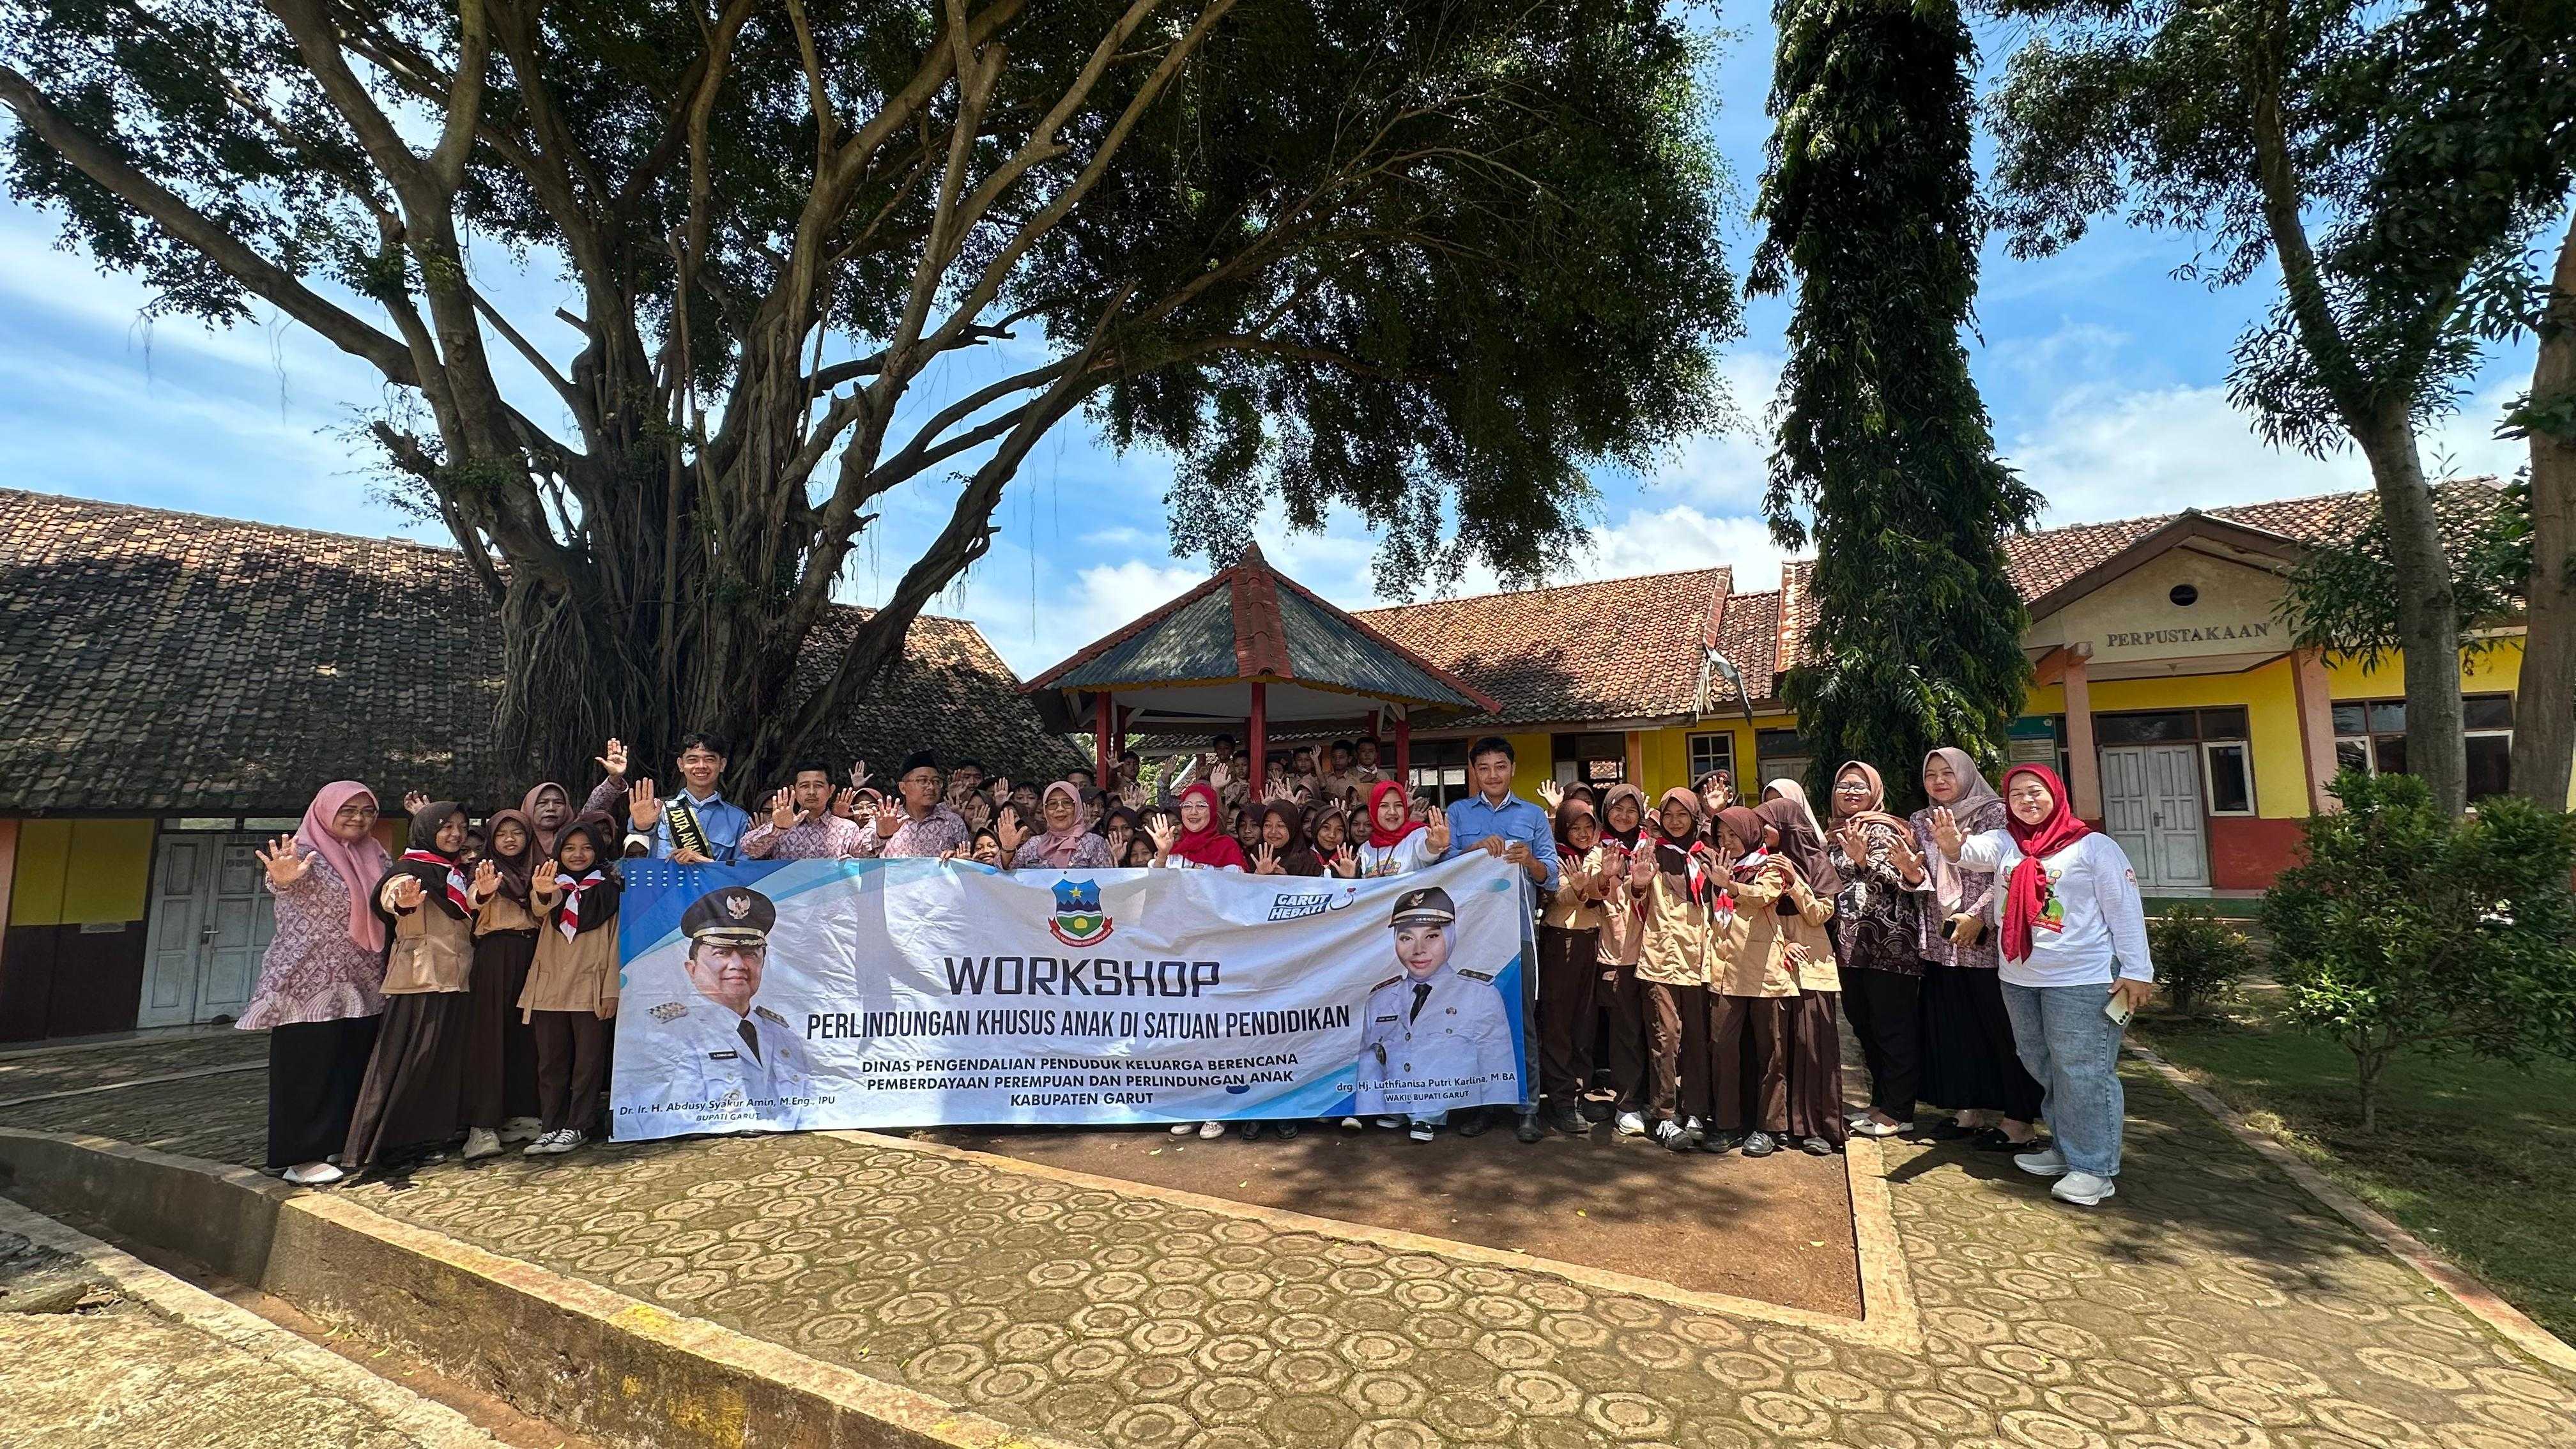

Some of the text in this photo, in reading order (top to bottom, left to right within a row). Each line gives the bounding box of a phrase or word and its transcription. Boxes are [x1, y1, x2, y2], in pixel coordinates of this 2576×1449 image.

[2107, 623, 2269, 647] PERPUSTAKAAN
[670, 809, 702, 853] DUTA ANA
[1278, 894, 1330, 906] GARUT
[944, 956, 1220, 997] WORKSHOP
[807, 1005, 1350, 1039] PERLINDUNGAN KHUSUS ANAK DI SATUAN PENDIDIKAN
[862, 1054, 1298, 1072] DINAS PENGENDALIAN PENDUDUK KELUARGA BERENCANA
[868, 1070, 1293, 1090] PEMBERDAYAAN PEREMPUAN DAN PERLINDUNGAN ANAK
[1358, 1081, 1371, 1091] Hj.
[1374, 1079, 1425, 1089] Luthfianisa
[1429, 1078, 1452, 1087] Putri
[1455, 1076, 1487, 1086] Karlina,
[1011, 1092, 1153, 1106] KABUPATEN GARUT
[1413, 1092, 1440, 1101] BUPATI
[1443, 1090, 1469, 1099] GARUT
[620, 1106, 634, 1116] Dr.
[638, 1105, 648, 1114] Ir.
[652, 1103, 663, 1112] H.
[666, 1101, 705, 1112] Abdusy
[709, 1099, 744, 1110] Syakur
[746, 1098, 776, 1107] Amin,
[818, 1096, 835, 1105] IPU
[731, 1112, 760, 1121] GARUT
